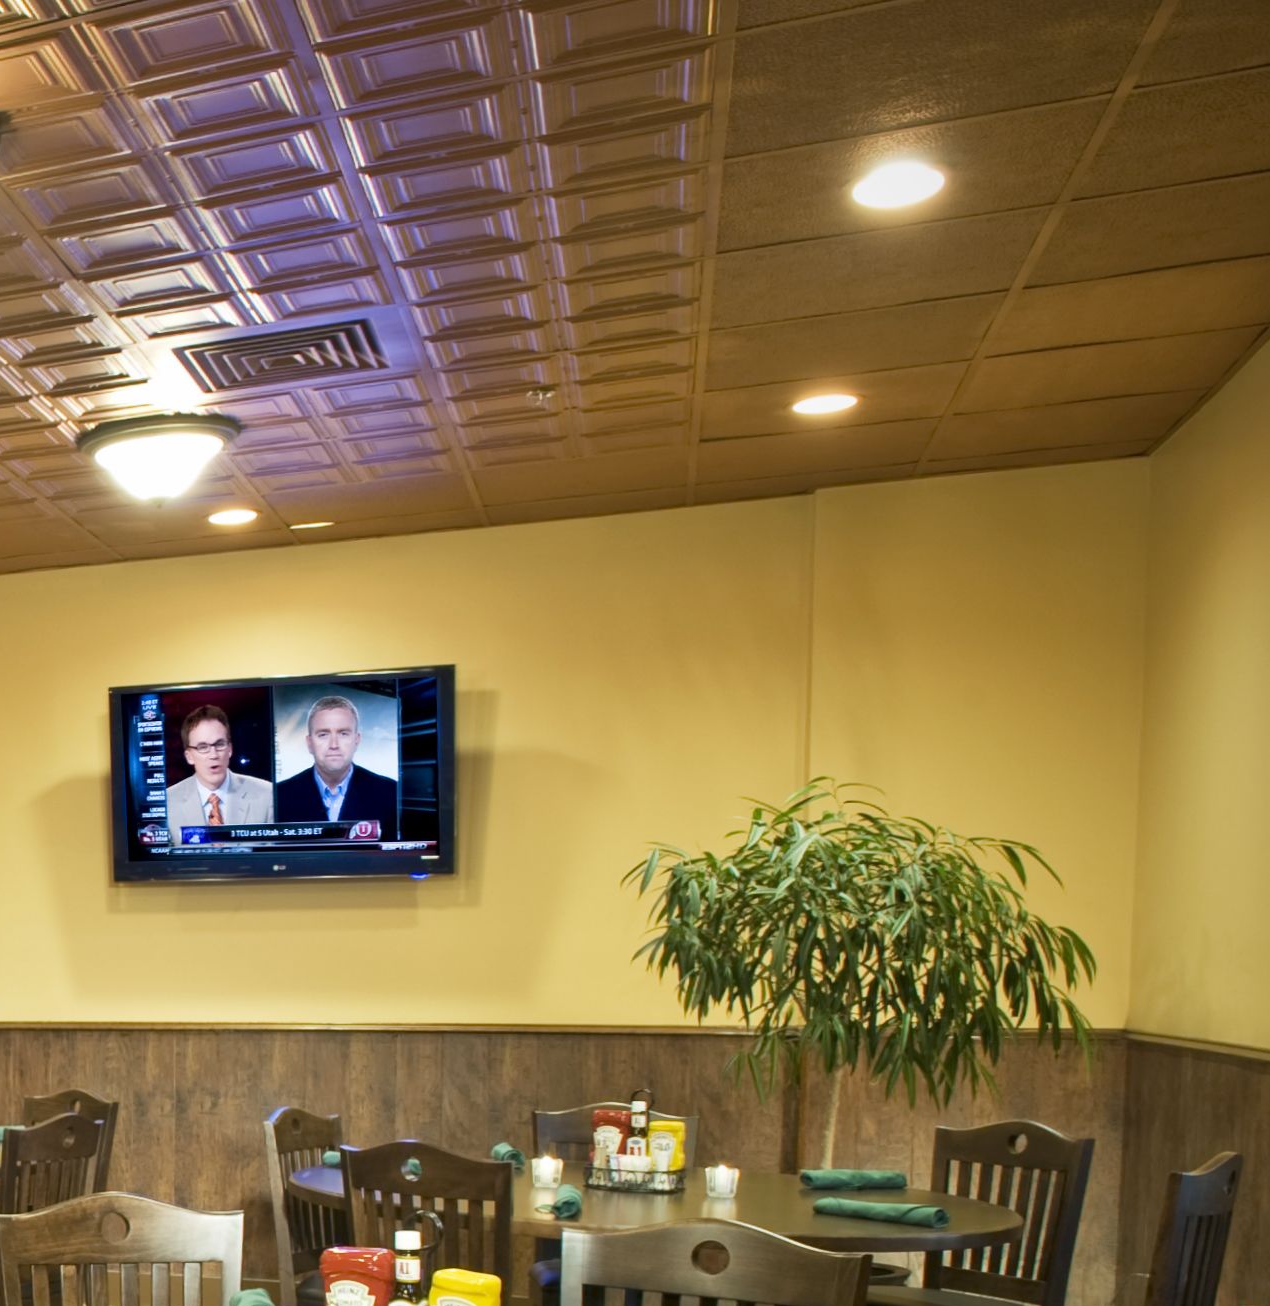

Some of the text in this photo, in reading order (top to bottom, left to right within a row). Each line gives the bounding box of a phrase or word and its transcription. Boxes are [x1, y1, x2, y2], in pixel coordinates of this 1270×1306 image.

[236, 829, 249, 837] TCU
[262, 827, 279, 836] Utah
[297, 827, 313, 836] 3:30
[313, 827, 324, 835] ET
